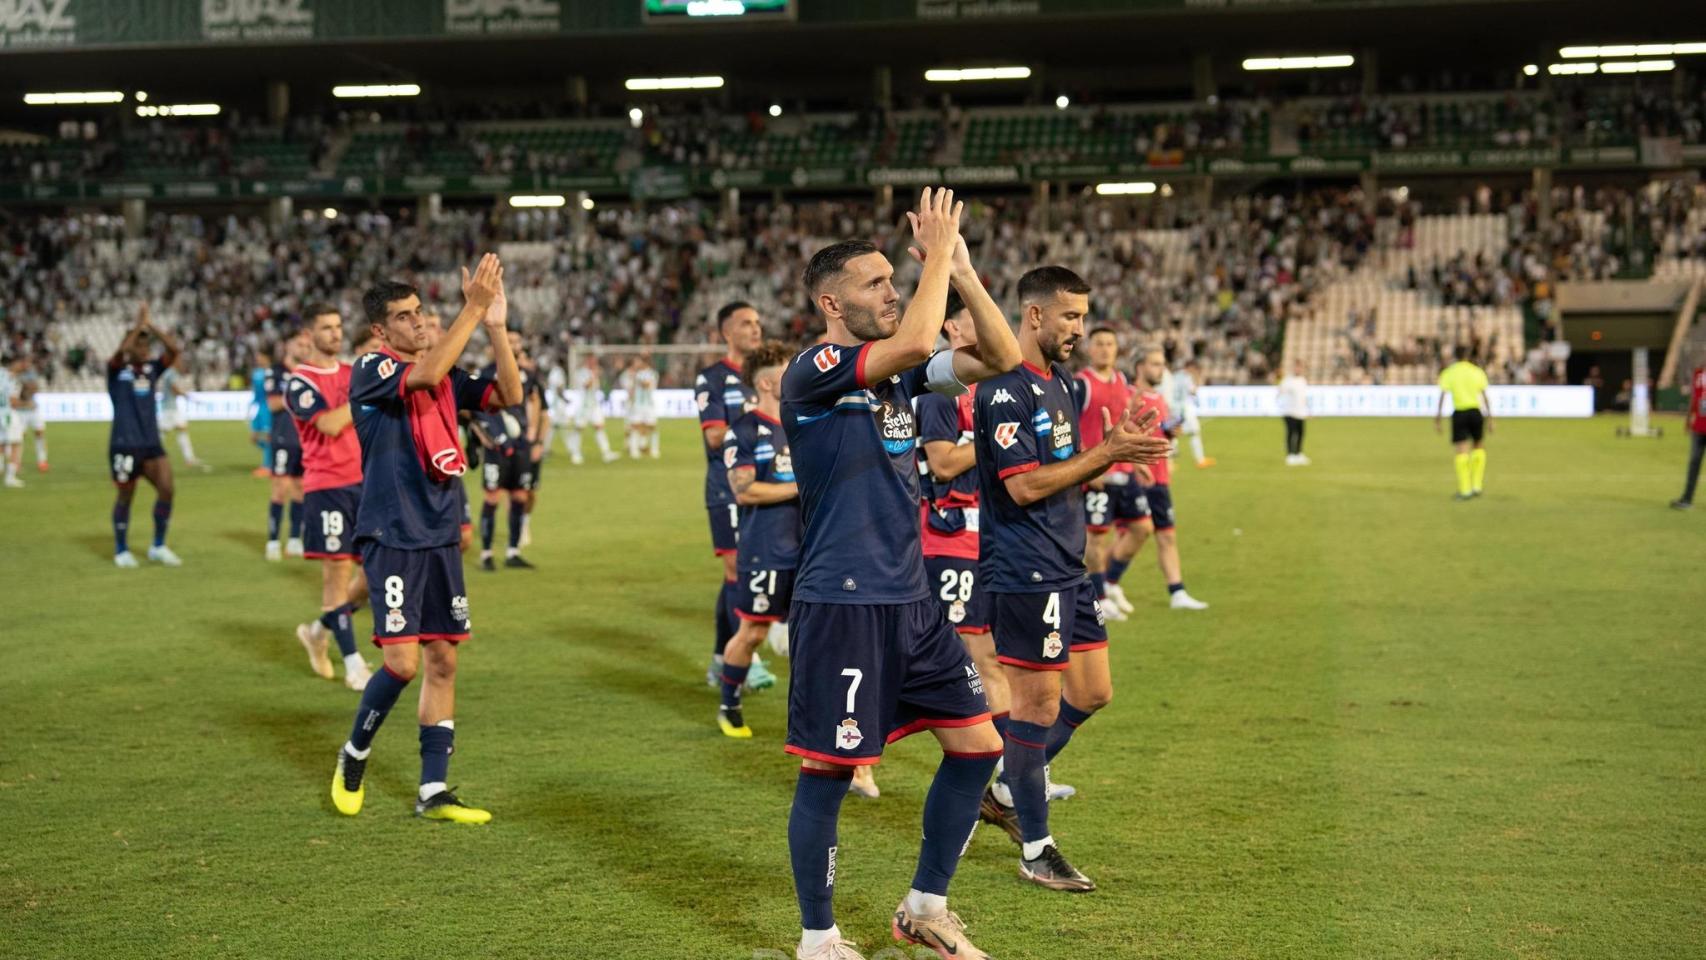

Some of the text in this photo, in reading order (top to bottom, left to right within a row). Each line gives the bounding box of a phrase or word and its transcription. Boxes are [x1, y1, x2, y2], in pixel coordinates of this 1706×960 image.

[1086, 492, 1110, 514] 22
[320, 510, 344, 536] 19
[384, 575, 404, 609] 8
[750, 569, 778, 595] 21
[939, 568, 974, 602] 28
[1042, 592, 1061, 630] 4
[840, 668, 864, 714] 7
